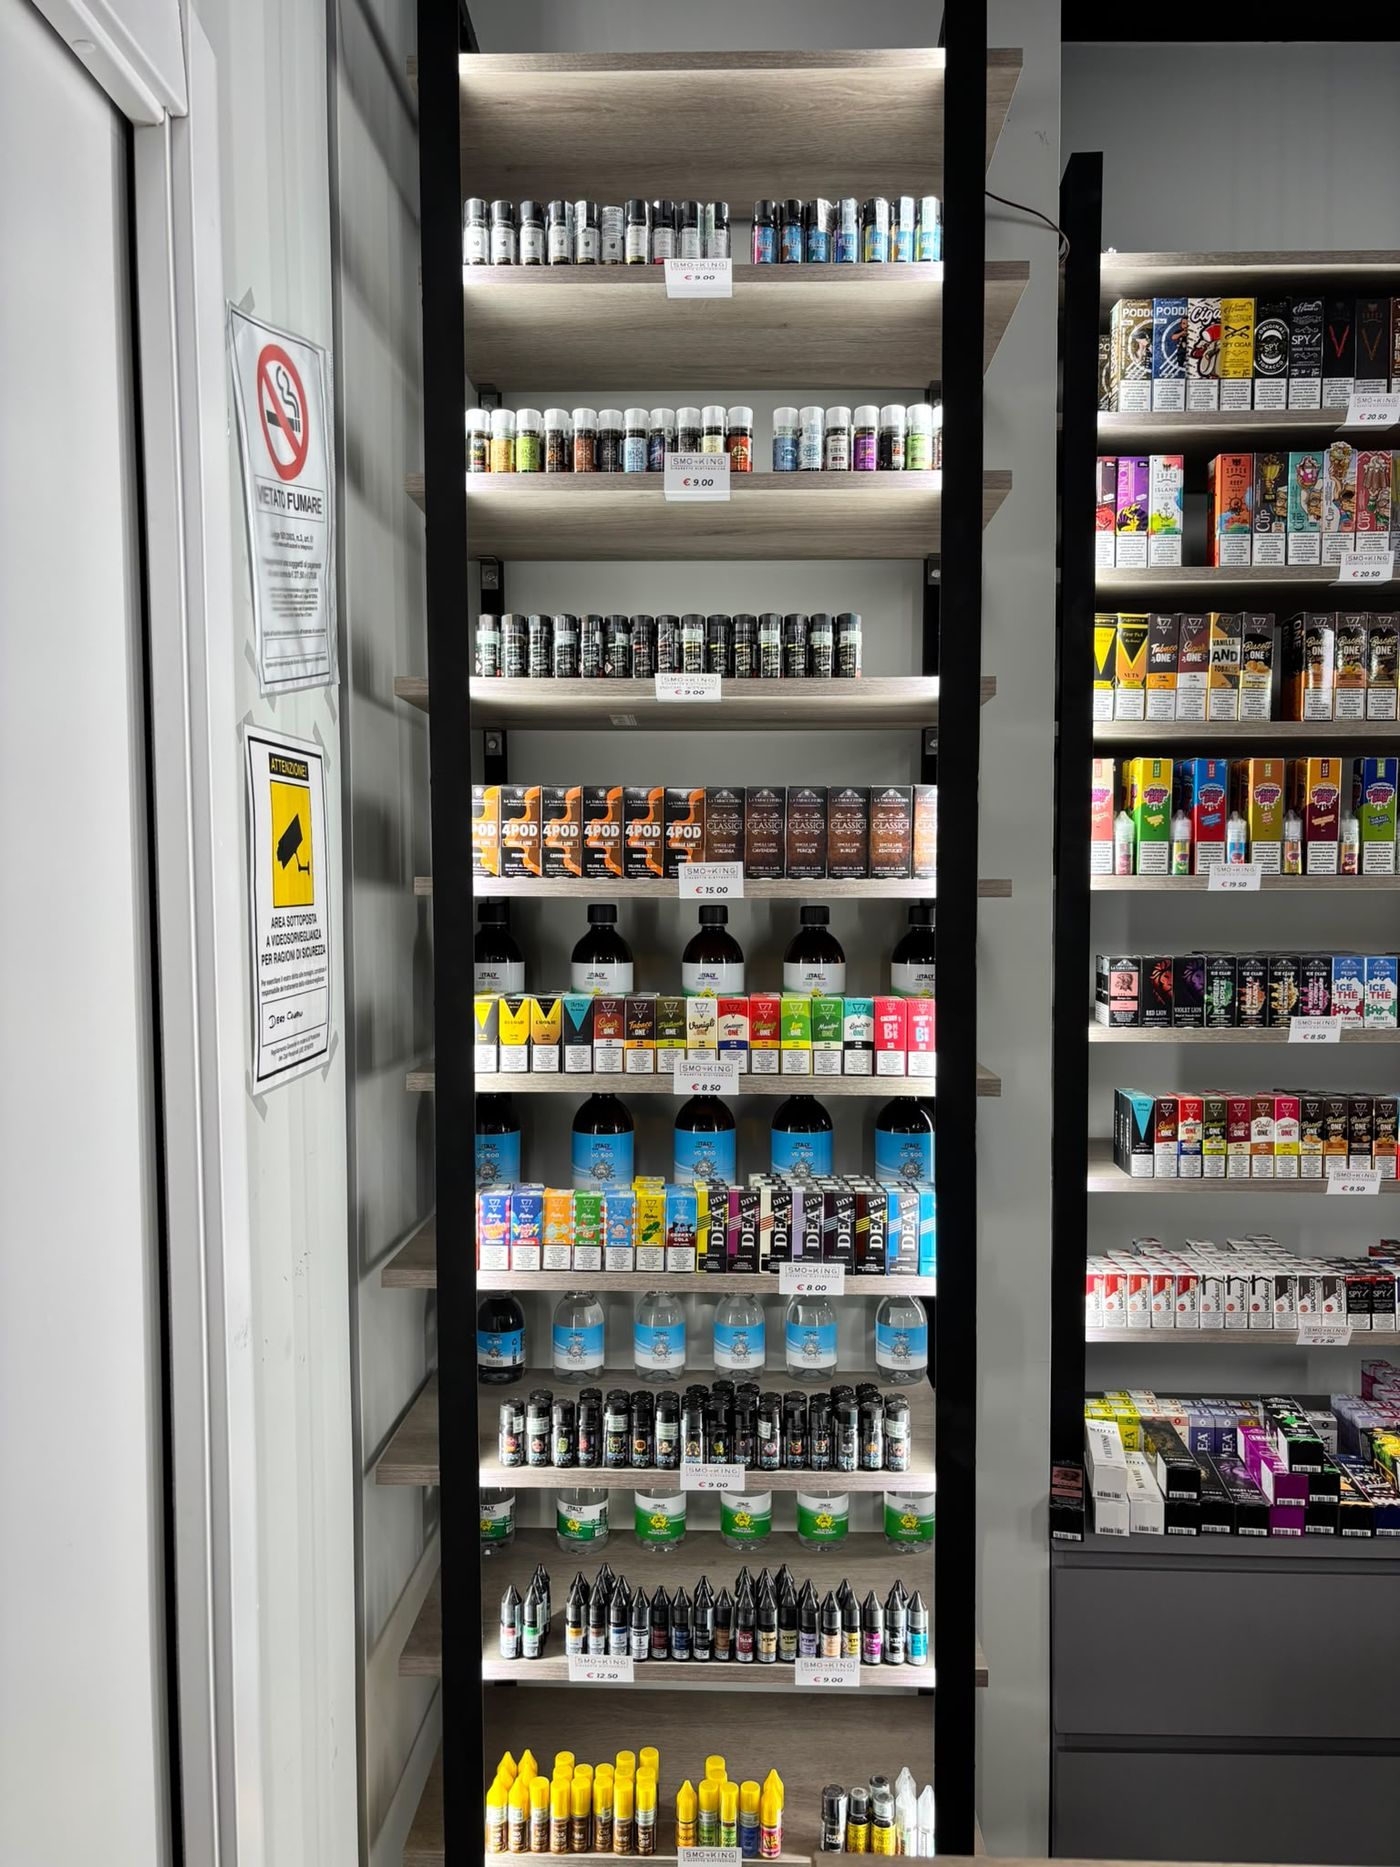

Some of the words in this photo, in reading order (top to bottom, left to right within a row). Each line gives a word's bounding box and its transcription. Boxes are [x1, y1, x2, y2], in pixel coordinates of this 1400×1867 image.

[1291, 335, 1310, 345] SPY
[1264, 342, 1279, 353] SPY
[287, 492, 322, 514] FUMARE
[1212, 649, 1238, 663] AND
[1249, 651, 1265, 660] ONE
[1344, 646, 1360, 655] ONE
[1376, 646, 1391, 655] ONE
[1156, 653, 1171, 662] ONE
[1186, 653, 1202, 662] ONE
[502, 824, 538, 837] 4POD
[543, 824, 579, 837] 4POD
[584, 824, 620, 837] 4POD
[625, 824, 661, 837] 4POD
[707, 822, 743, 830] CLASSICI
[747, 822, 783, 830] CLASSICI
[788, 821, 824, 830] CLASSICI
[830, 821, 867, 830] CLASSICI
[872, 821, 909, 830] CLASSICI
[666, 826, 701, 839] 4POD
[271, 917, 286, 928] AREA
[286, 913, 317, 927] SOTTOPOSTA
[265, 935, 270, 947] A
[261, 953, 272, 966] PER
[273, 949, 295, 964] RAGIONI
[296, 948, 301, 960] DI
[1336, 983, 1353, 991] ICE
[1369, 983, 1385, 991] ICE
[710, 1195, 723, 1205] DIY
[740, 1196, 754, 1207] DIY
[772, 1196, 786, 1206] DIY
[804, 1196, 818, 1207] DIY
[836, 1197, 849, 1207] DIY
[868, 1197, 882, 1208] DIY
[900, 1197, 913, 1209] DIY
[711, 1207, 725, 1247] DEA
[741, 1208, 755, 1248] DEA
[774, 1208, 788, 1248] DEA
[806, 1209, 820, 1249] DEA
[837, 1209, 851, 1249] DEA
[869, 1210, 883, 1249] DEA
[901, 1210, 916, 1251] DEA
[1197, 1433, 1209, 1452] EA
